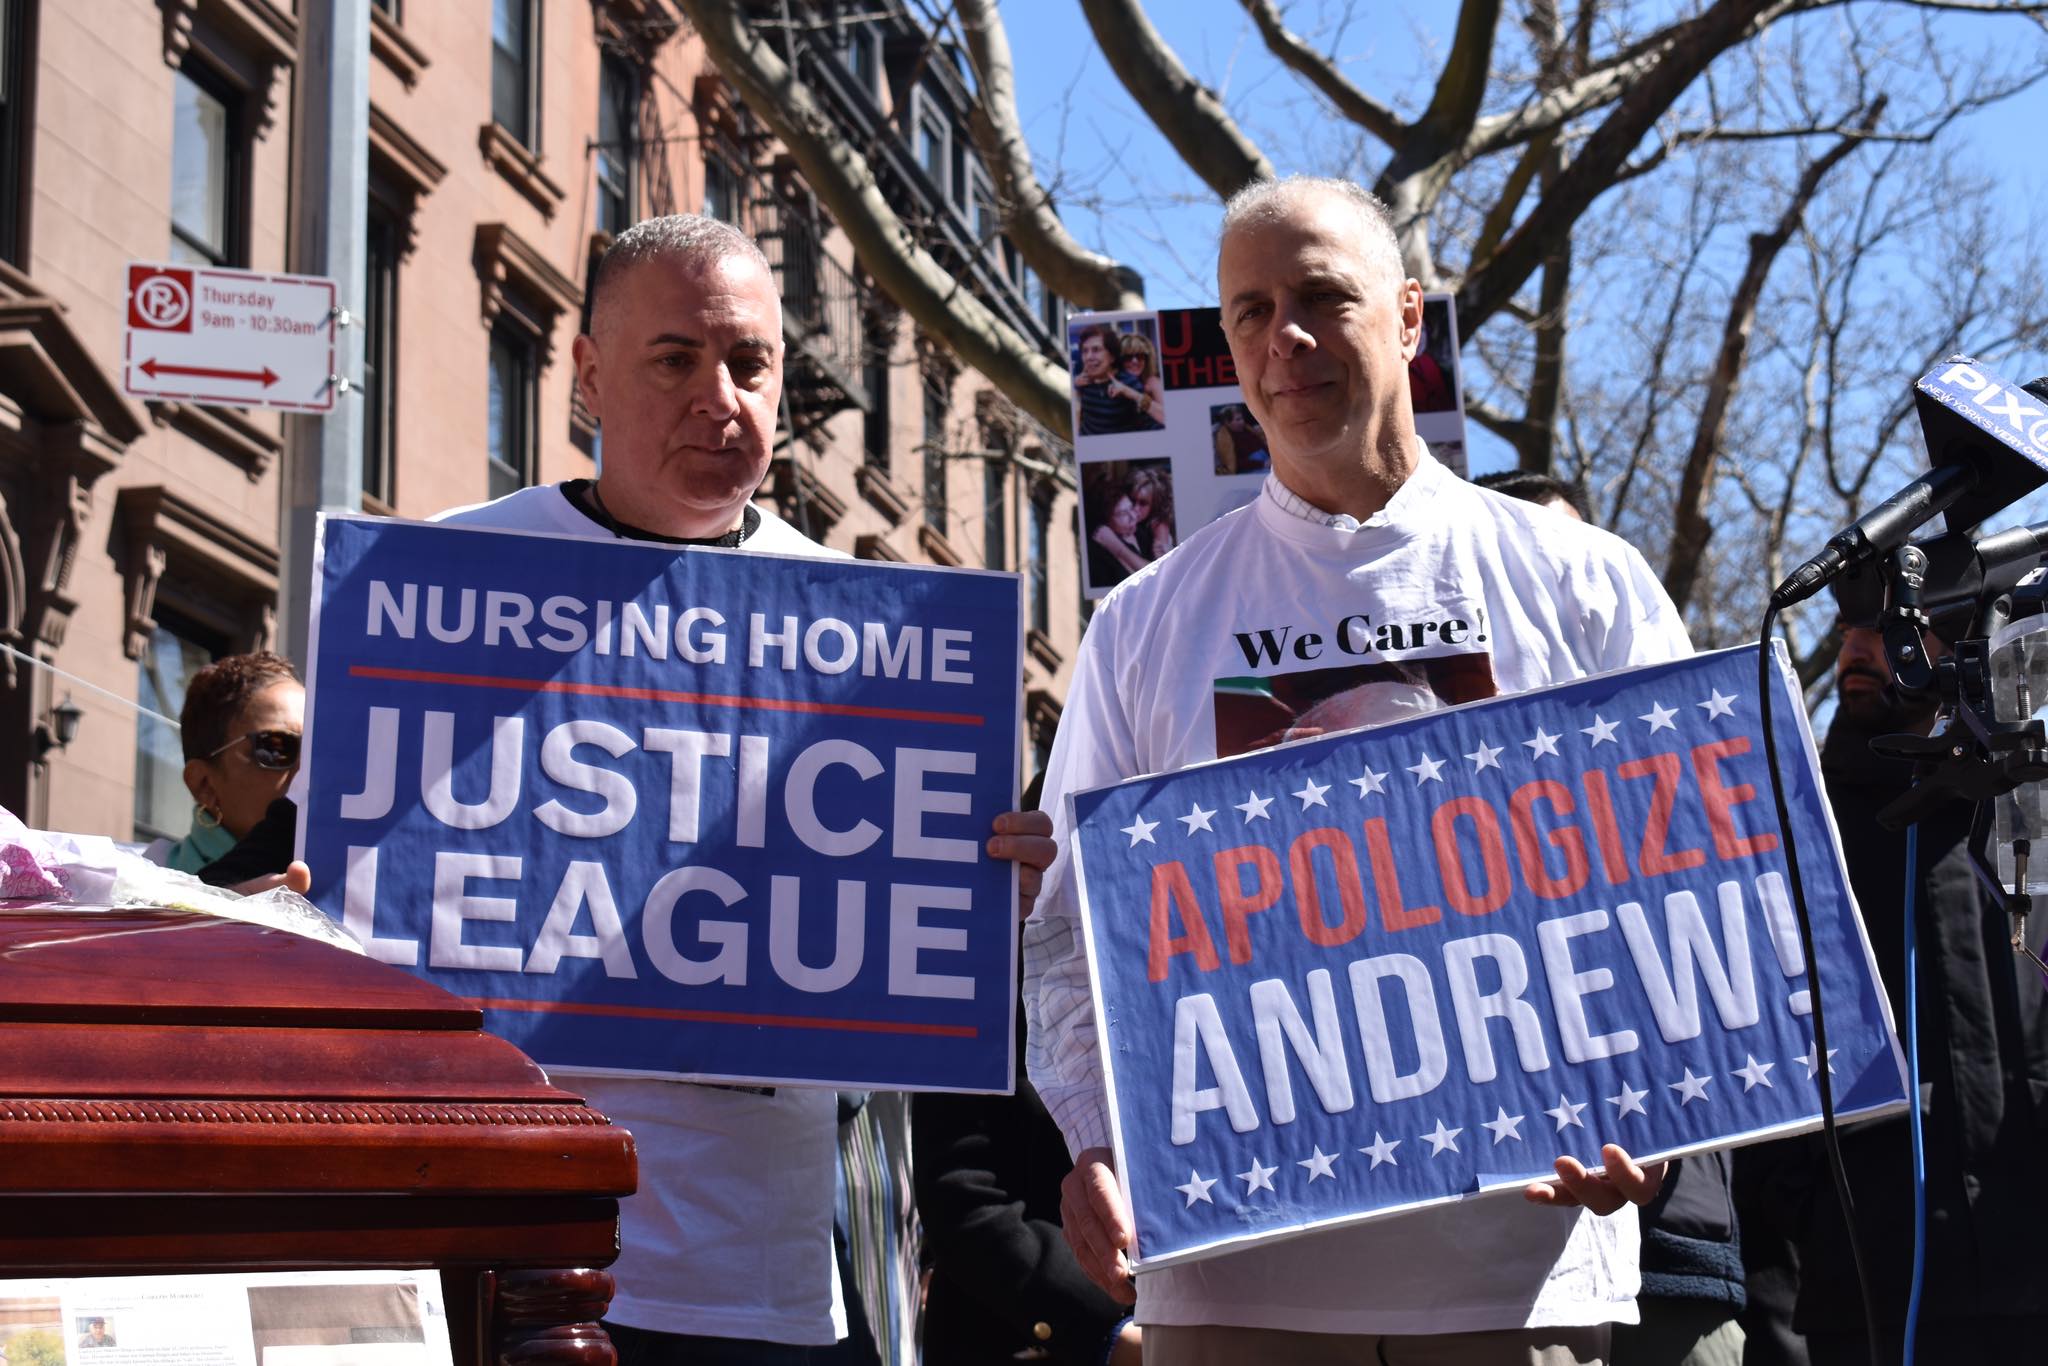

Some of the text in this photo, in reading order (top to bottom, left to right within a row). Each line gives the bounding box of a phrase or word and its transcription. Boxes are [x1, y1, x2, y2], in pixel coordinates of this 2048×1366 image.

[201, 311, 236, 329] 9am
[250, 315, 317, 336] 10:30am
[203, 286, 275, 309] Thursday
[1924, 383, 1956, 403] NEW
[1953, 400, 1995, 429] YORK'S
[1993, 425, 2026, 451] VERY
[366, 579, 975, 685] NURSING HOME
[1233, 607, 1487, 669] We Care!
[340, 705, 979, 864] JUSTICE
[1146, 736, 1779, 984] APOLOGIZE
[342, 846, 977, 1000] LEAGUE
[1170, 872, 1814, 1147] ANDREW!
